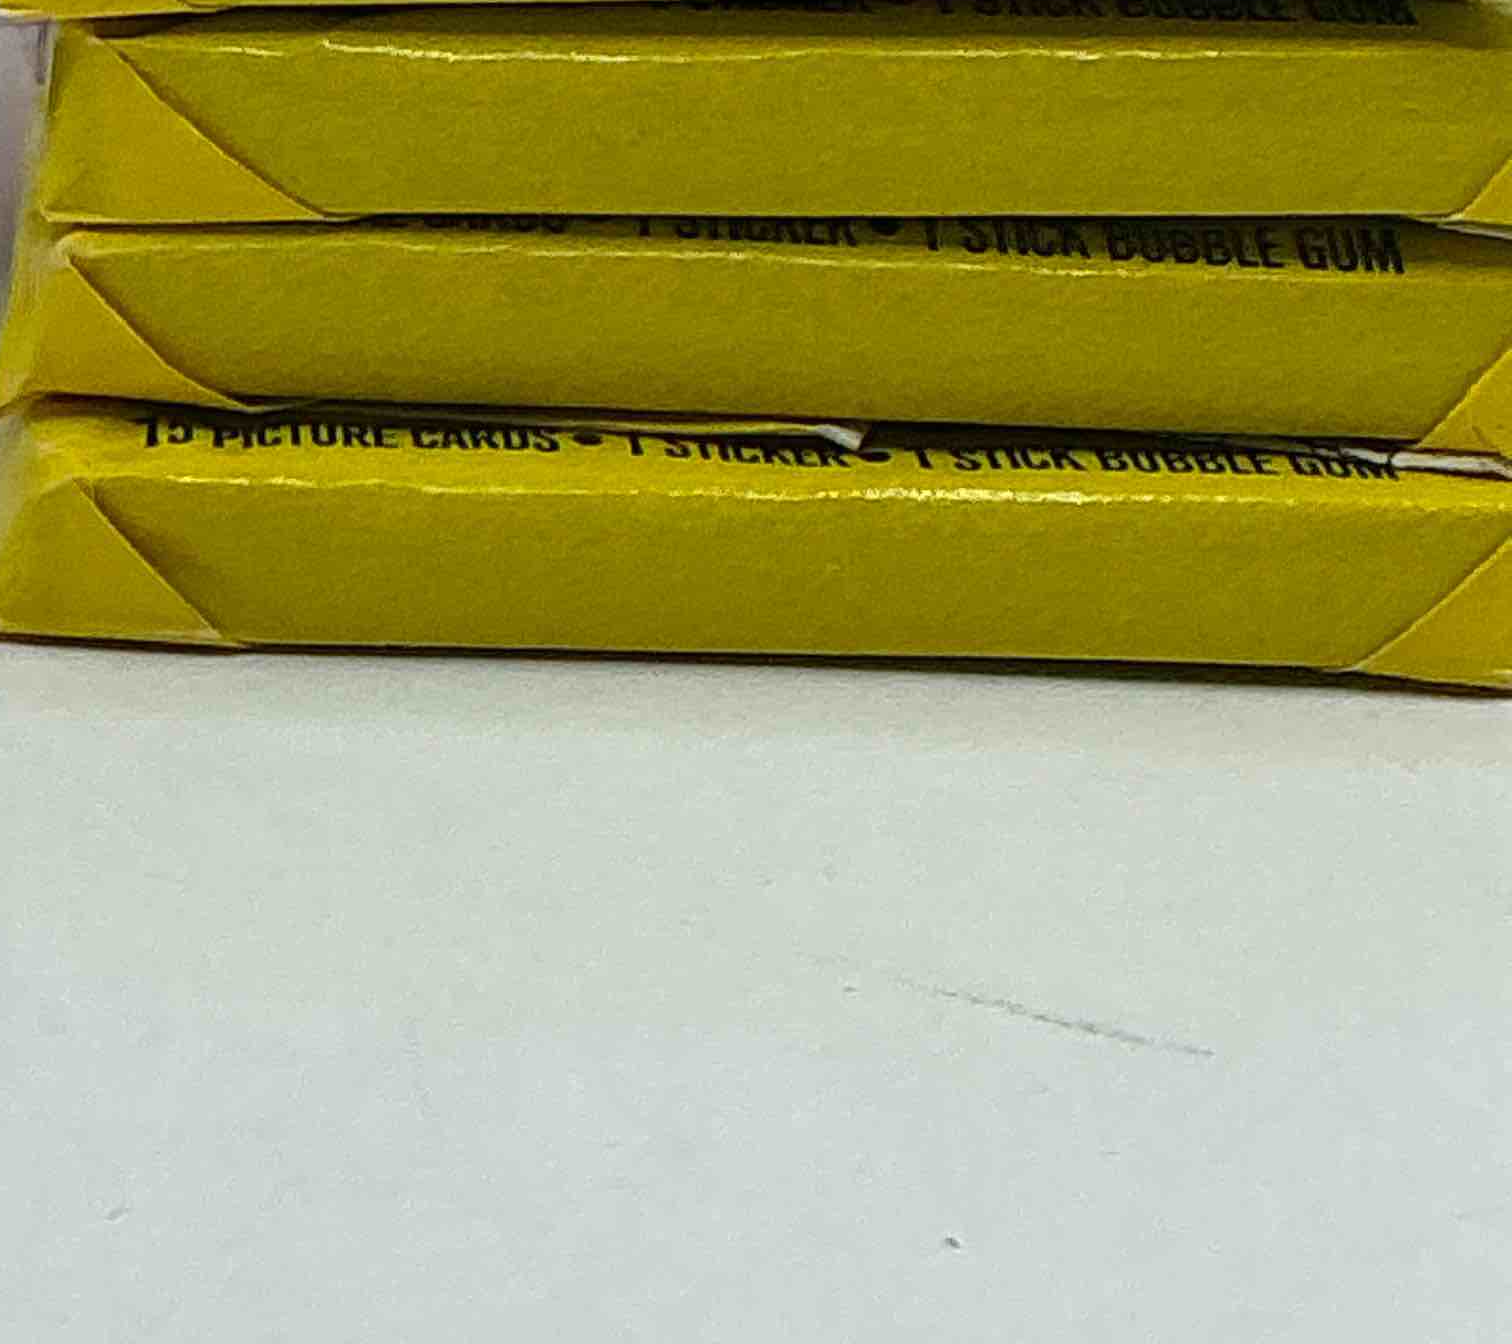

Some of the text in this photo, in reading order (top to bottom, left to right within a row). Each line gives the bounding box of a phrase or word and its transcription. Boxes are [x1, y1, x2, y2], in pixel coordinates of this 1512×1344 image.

[960, 215, 1092, 258] STICK
[1104, 215, 1286, 268] BUBBLE
[1294, 220, 1406, 274] GUM
[212, 421, 401, 450] PICTURE
[411, 425, 563, 453] CARDS
